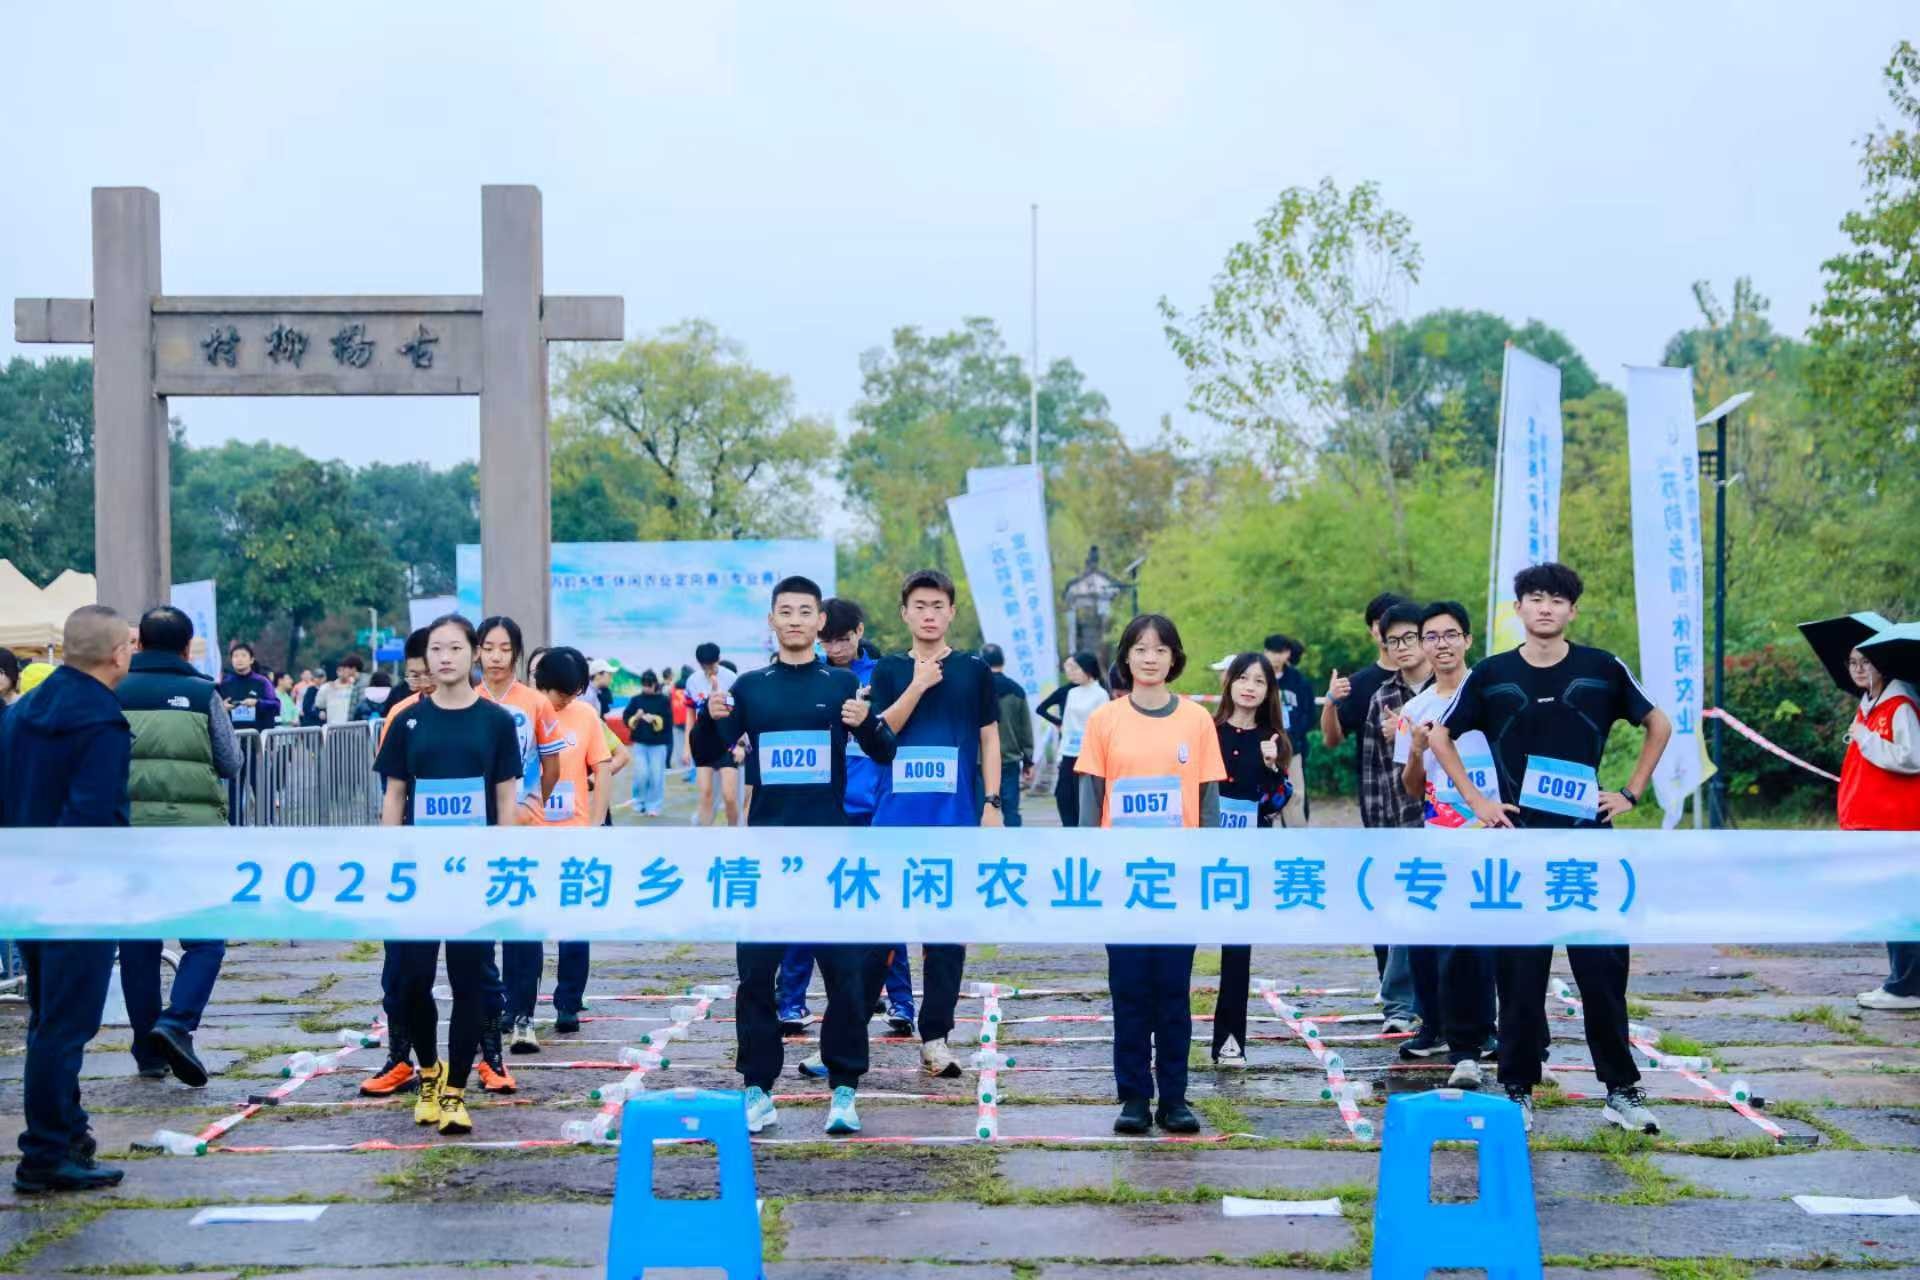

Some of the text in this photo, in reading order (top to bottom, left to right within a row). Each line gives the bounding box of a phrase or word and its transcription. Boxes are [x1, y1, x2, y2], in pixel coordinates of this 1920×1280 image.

[771, 748, 817, 768] A020
[904, 761, 945, 779] A009
[1537, 775, 1587, 801] C097
[425, 796, 472, 816] B002
[1122, 793, 1168, 814] D057
